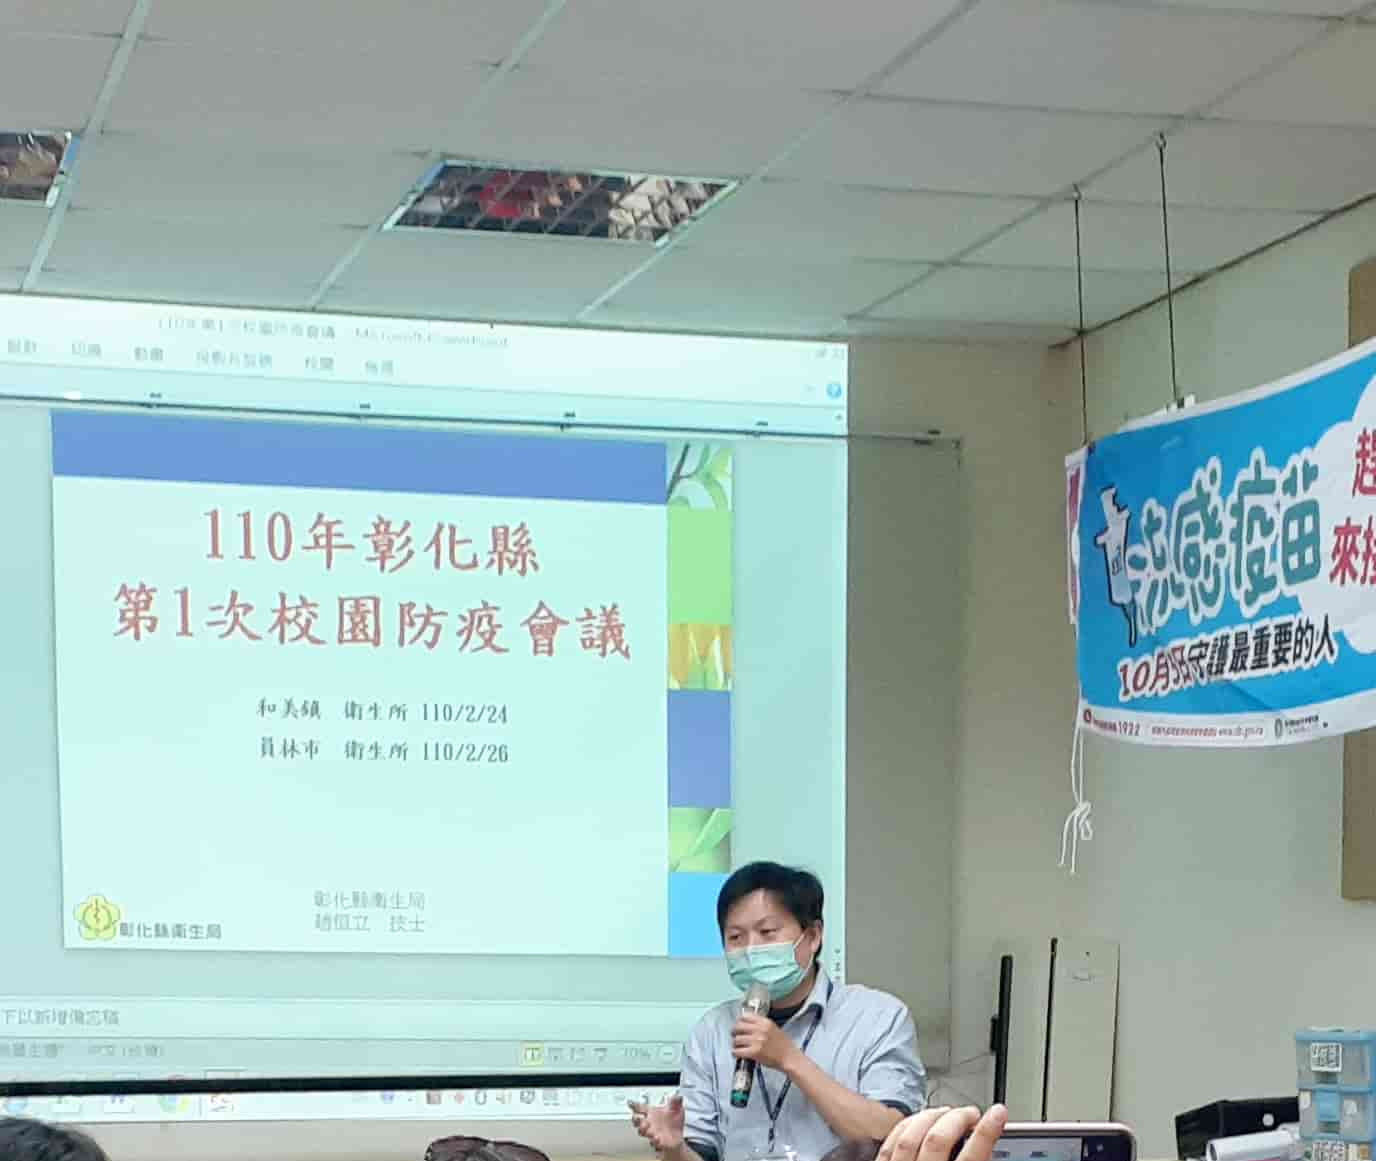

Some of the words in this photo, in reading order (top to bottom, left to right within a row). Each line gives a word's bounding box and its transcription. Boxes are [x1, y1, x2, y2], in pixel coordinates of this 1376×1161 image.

[203, 507, 541, 577] 110年彰化縣
[1126, 455, 1322, 629] 流感疫苗
[112, 580, 631, 661] 第1次校園防疫會議
[344, 699, 410, 723] 衛生所
[421, 702, 509, 726] 110/2/24
[258, 737, 321, 761] 員林市
[344, 739, 410, 763] 衛生所
[421, 742, 509, 765] 110/2/26
[118, 920, 222, 941] 彰化縣衛生局
